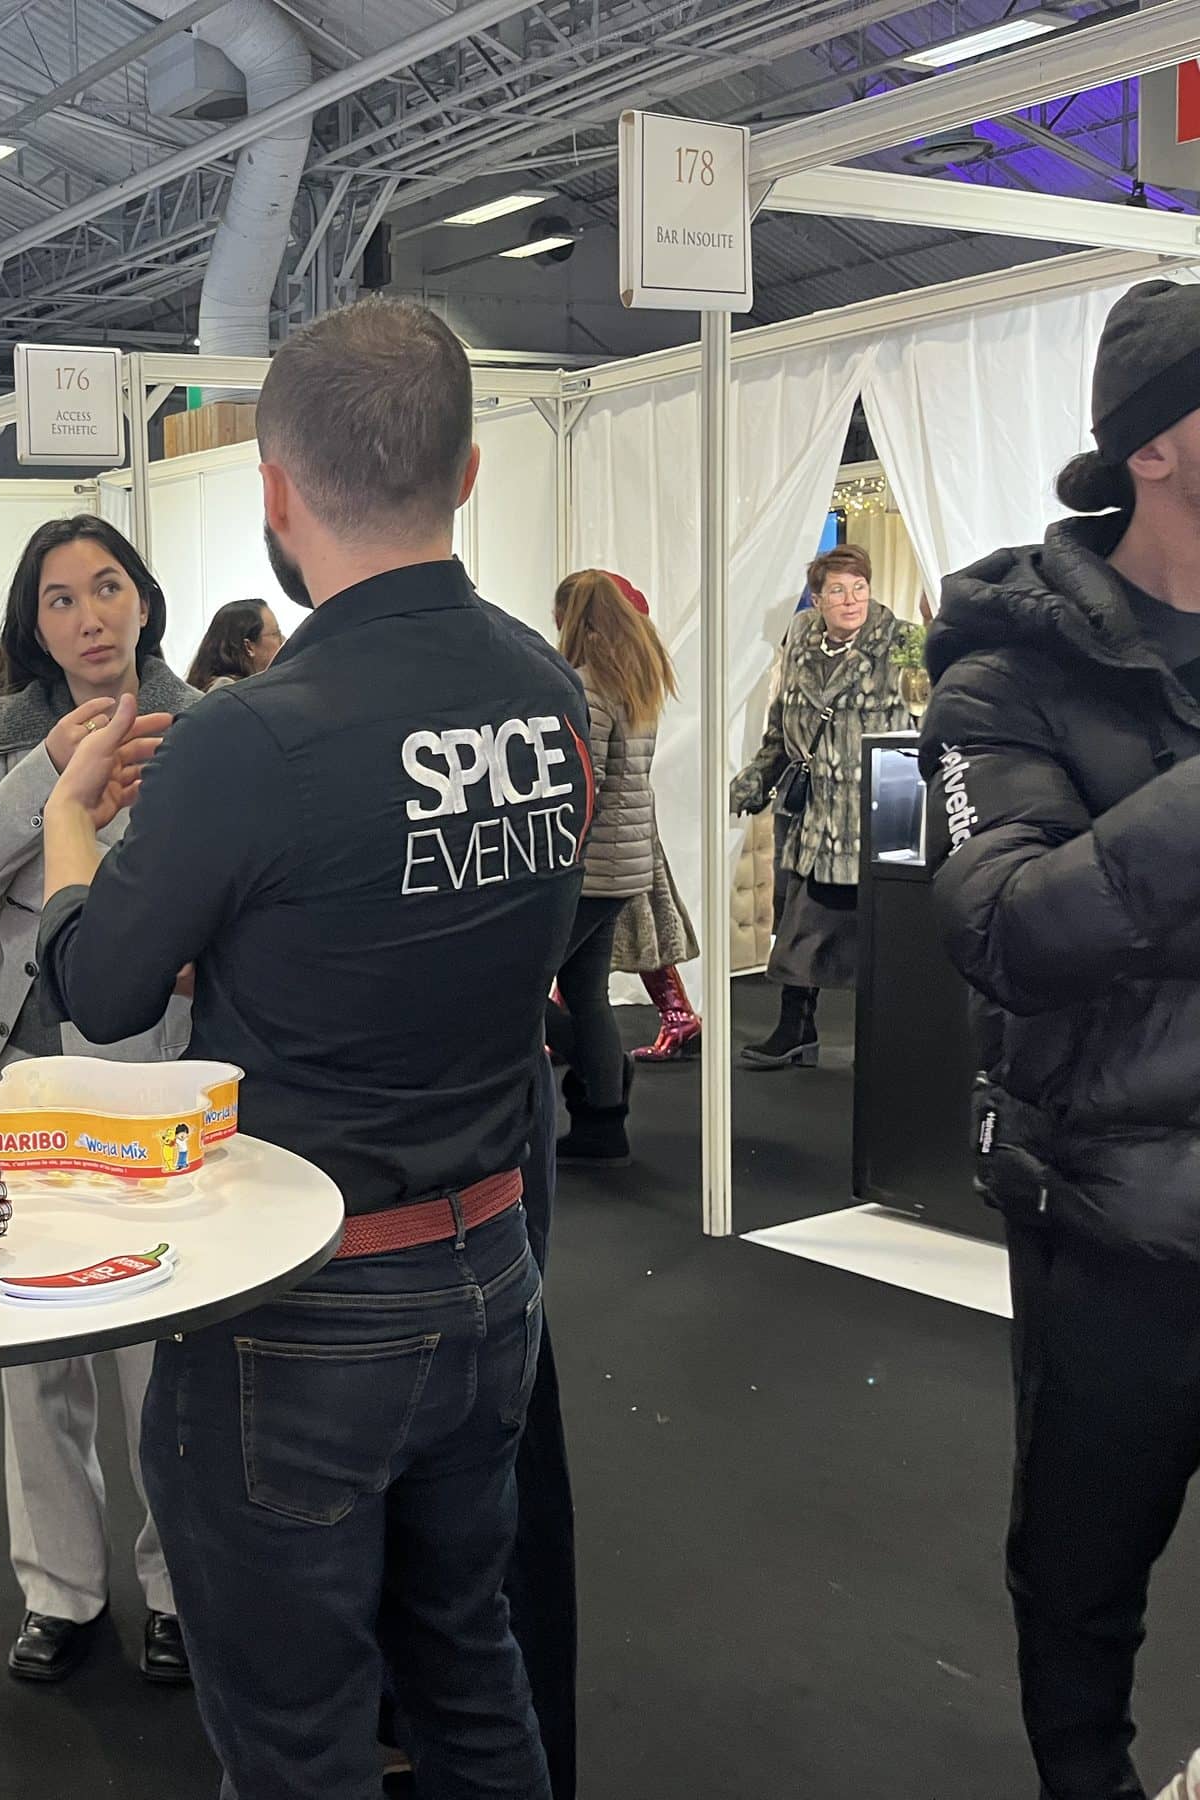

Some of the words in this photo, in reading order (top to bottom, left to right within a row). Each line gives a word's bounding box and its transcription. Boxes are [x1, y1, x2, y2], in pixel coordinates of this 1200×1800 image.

[675, 146, 715, 186] 178
[656, 226, 680, 245] BAR
[682, 228, 734, 249] INSOLITE
[56, 367, 90, 391] 176
[56, 410, 92, 421] ACCESS
[51, 423, 98, 436] ESTHETIC
[402, 716, 573, 821] SPICE
[402, 803, 577, 895] EVENTS
[85, 1136, 117, 1156] World
[121, 1142, 148, 1160] Mix
